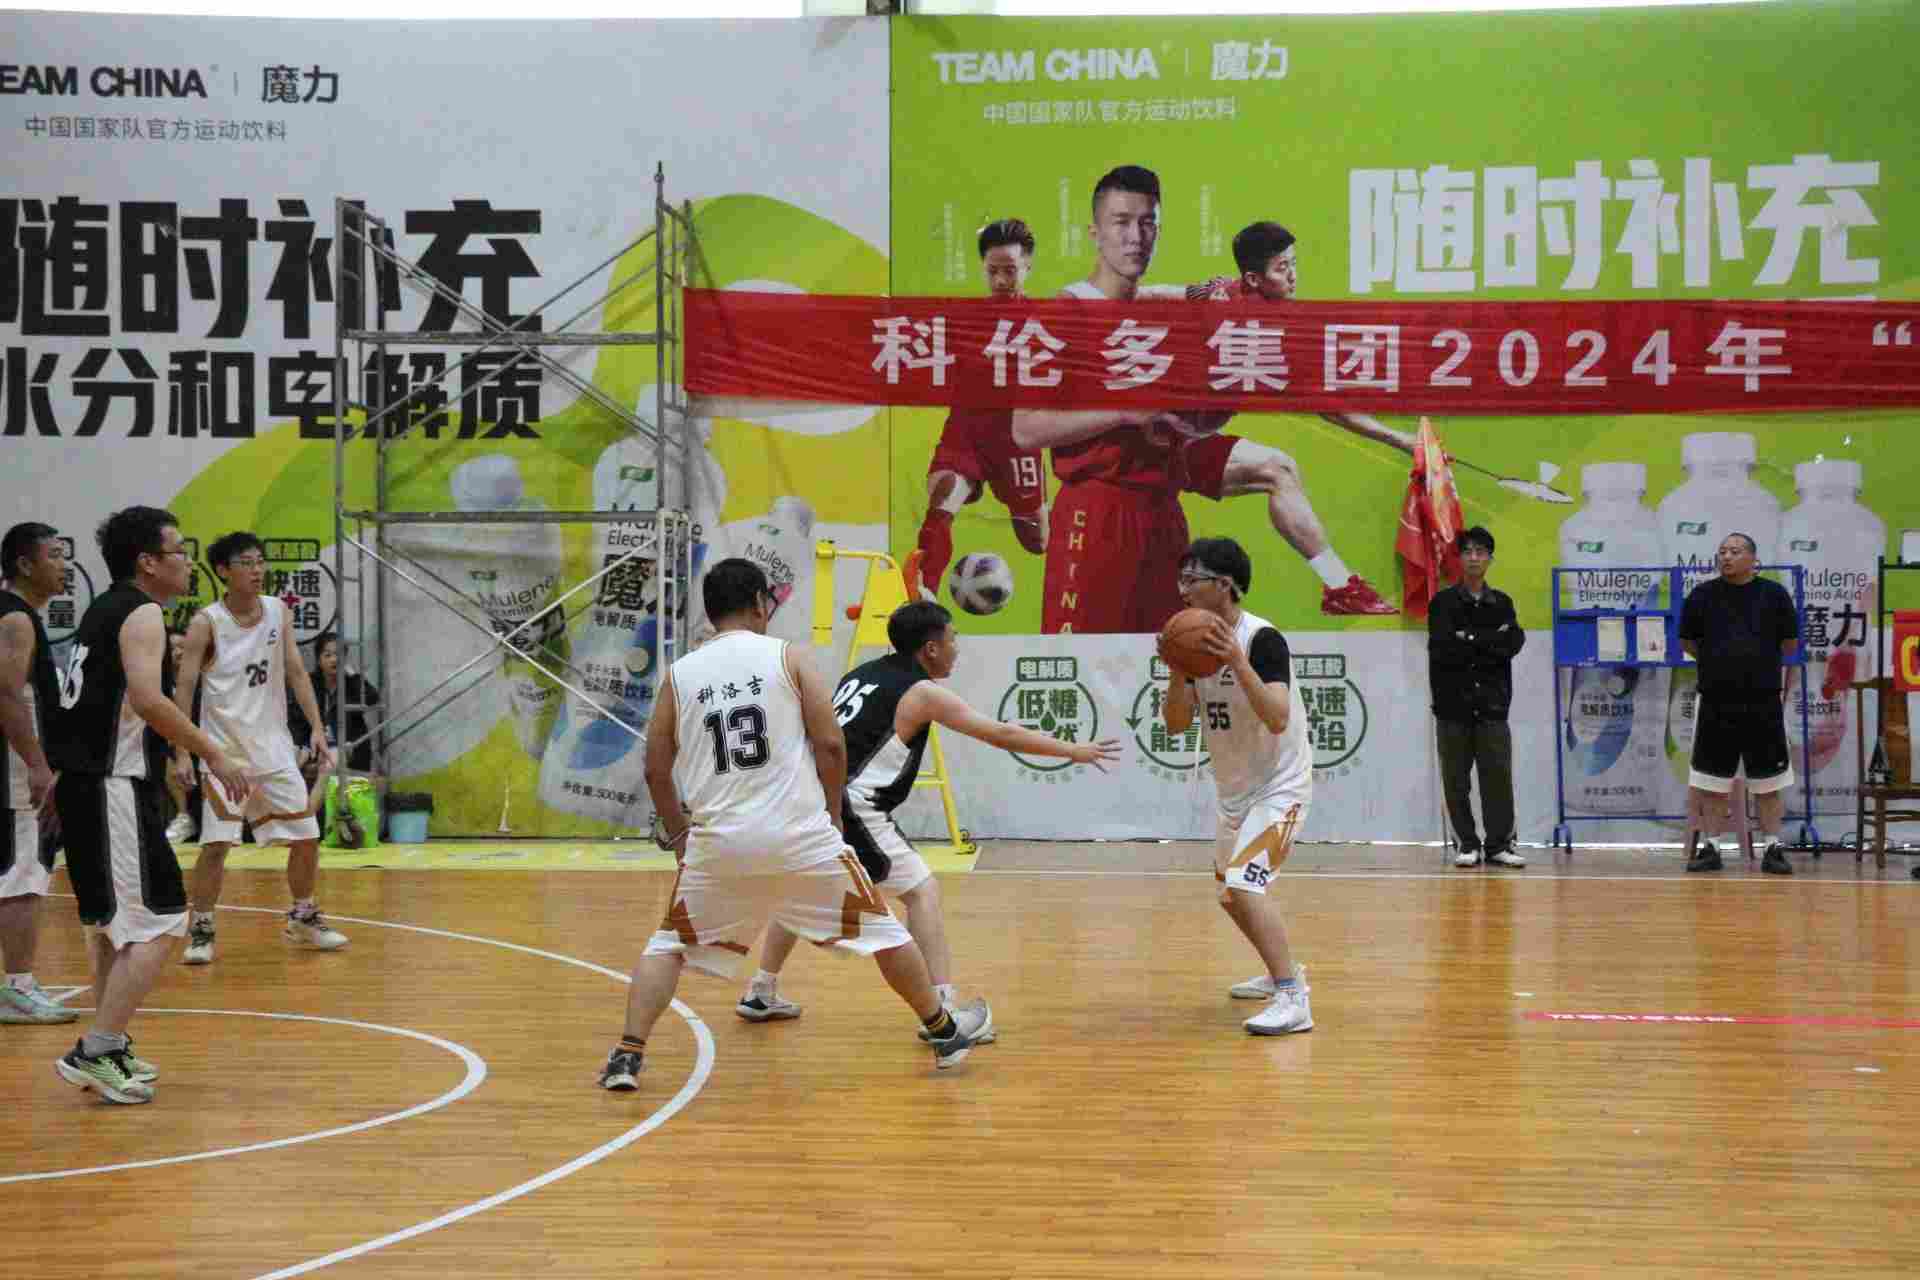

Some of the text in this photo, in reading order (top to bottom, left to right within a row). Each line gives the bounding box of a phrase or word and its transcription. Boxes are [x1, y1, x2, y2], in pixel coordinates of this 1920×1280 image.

[931, 47, 1160, 84] TEAM CHINA
[1211, 39, 1289, 81] 魔力
[0, 65, 208, 99] EAM CHINA
[261, 65, 340, 104] 魔力
[983, 97, 1237, 125] 中国国家队官方运动饮料
[24, 115, 286, 142] 中国国家队官方运动饮料
[1349, 153, 1880, 293] 随时补充
[0, 195, 542, 339] 随时补充
[1010, 456, 1039, 487] 19
[1578, 569, 1651, 589] Mulene
[1017, 688, 1079, 719] 低糖
[1207, 702, 1231, 730] 55
[703, 704, 770, 775] 13
[1243, 862, 1271, 887] 55
